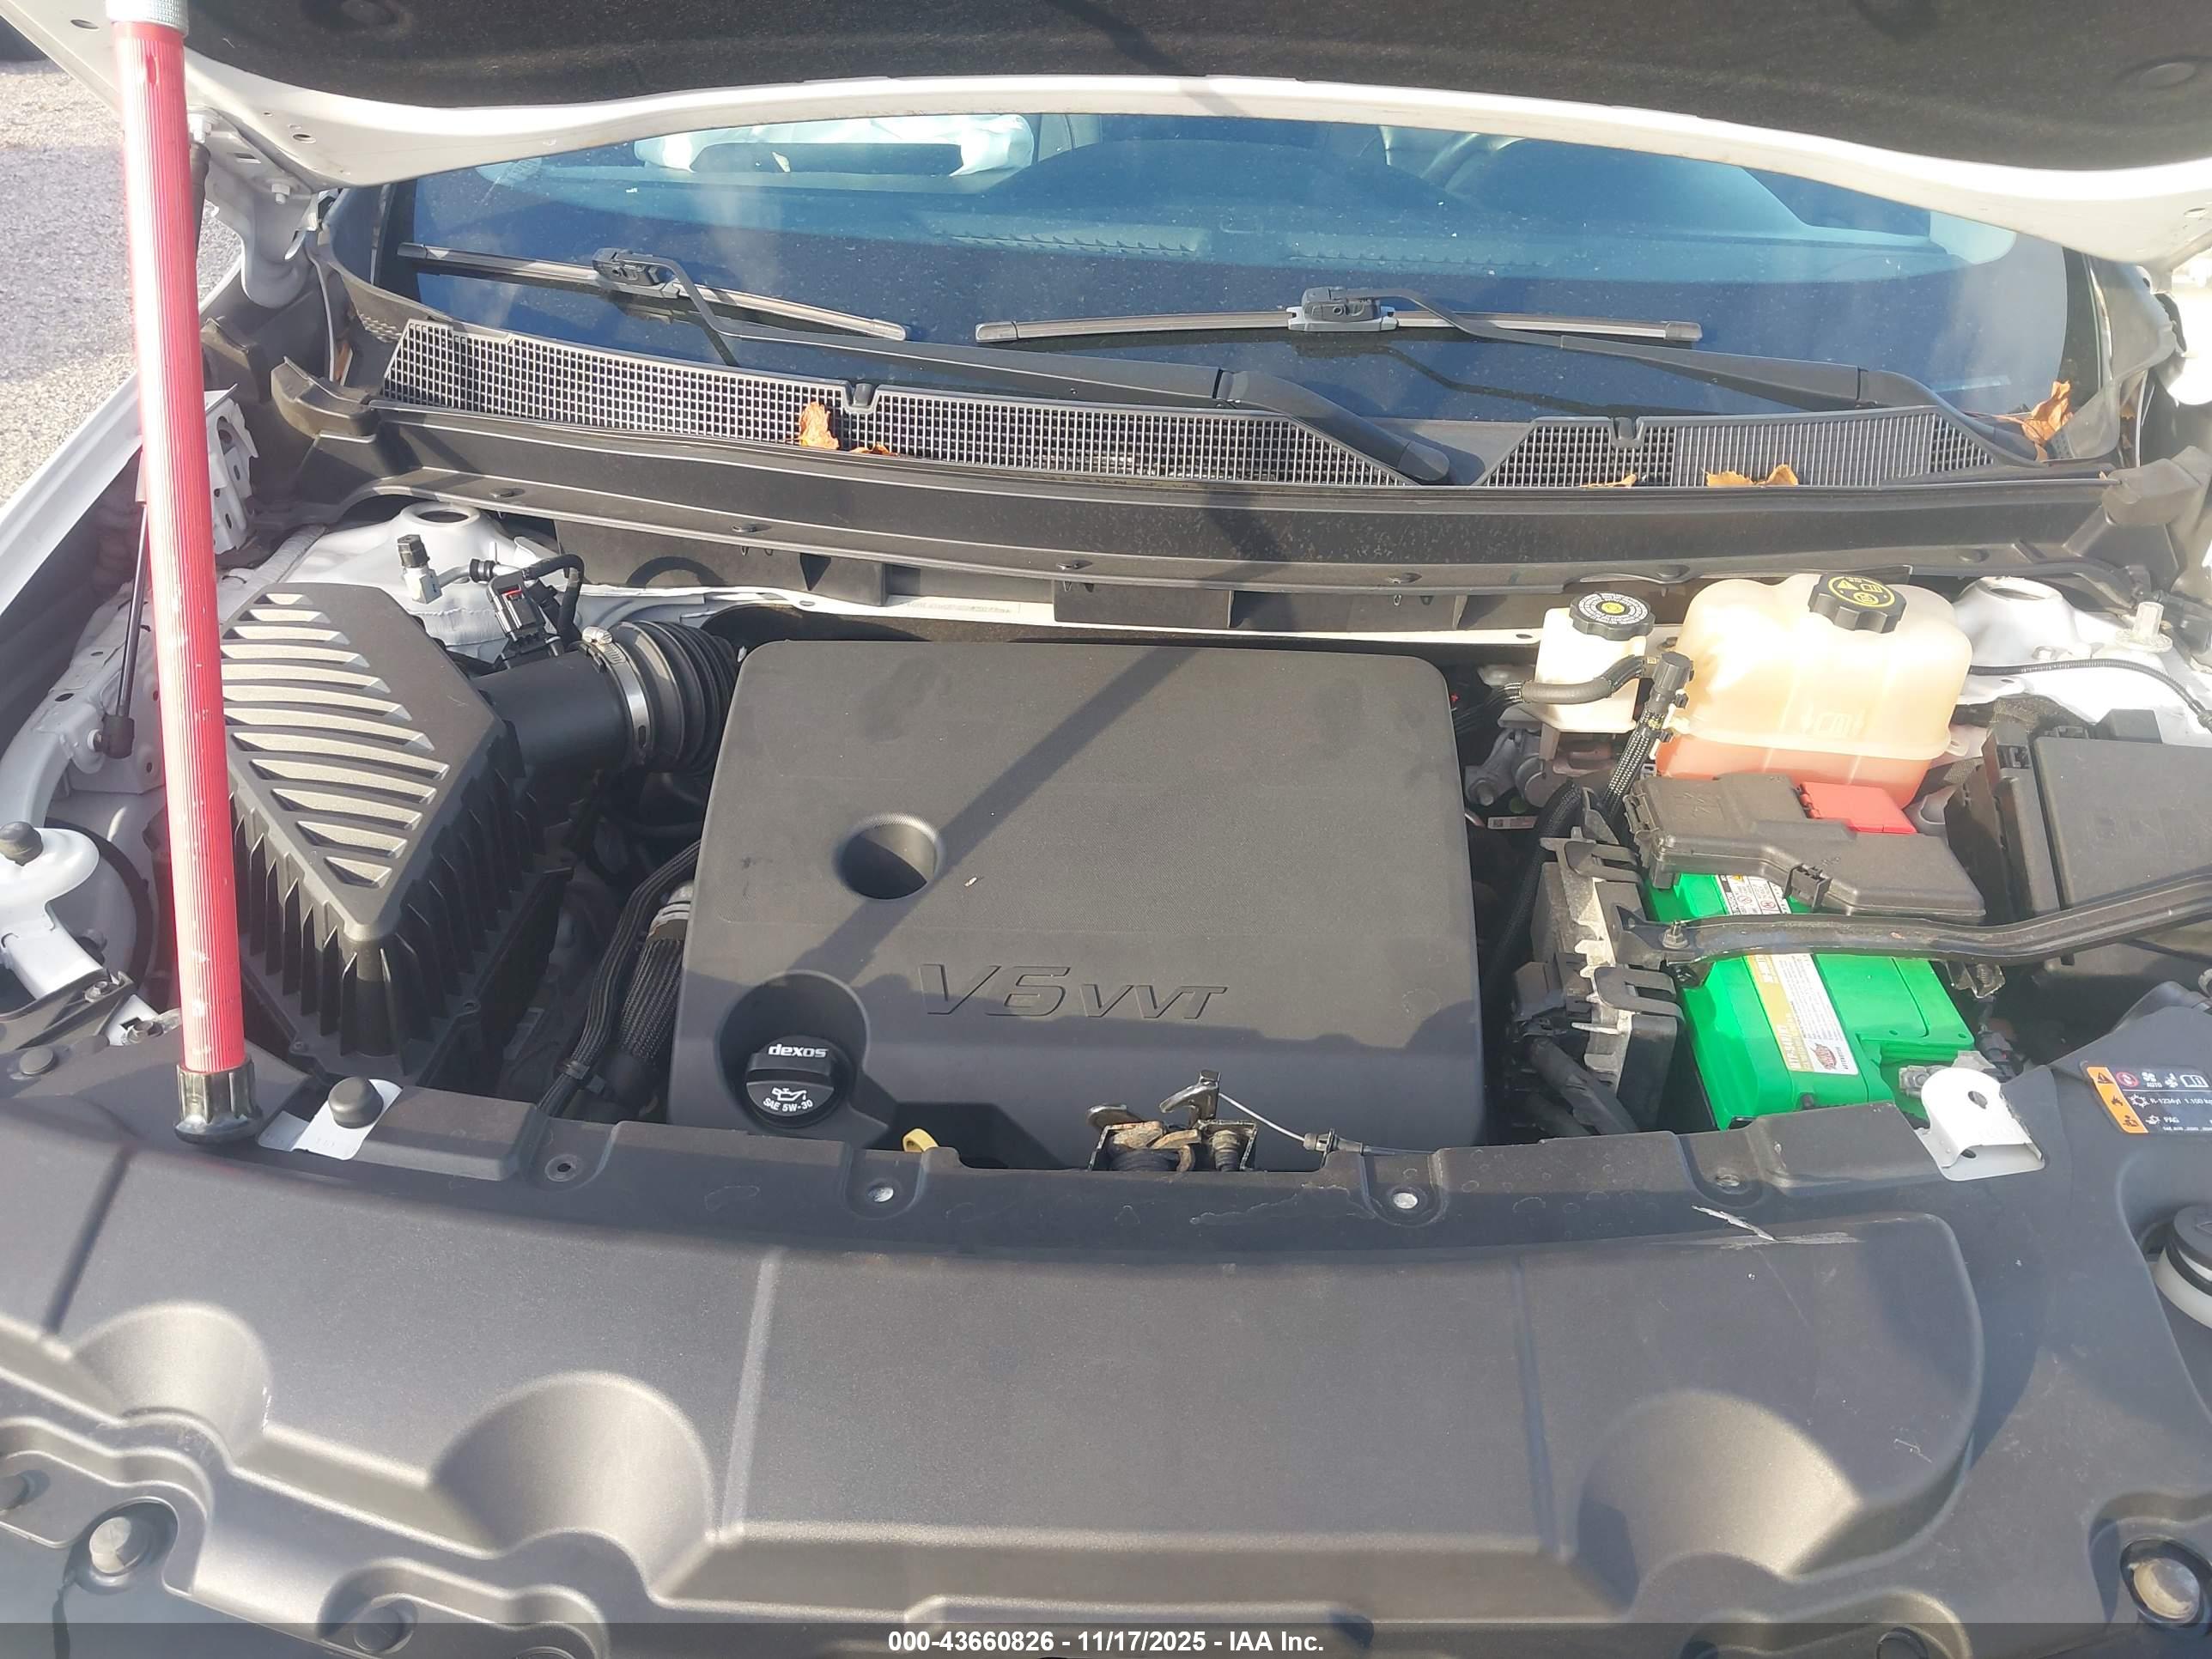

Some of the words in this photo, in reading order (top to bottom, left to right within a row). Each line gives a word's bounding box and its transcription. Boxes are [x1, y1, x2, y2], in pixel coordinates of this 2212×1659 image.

[918, 963, 1071, 1017] V6
[1079, 983, 1229, 1019] VVT
[768, 1043, 830, 1058] dexos
[763, 1097, 781, 1111] SAE
[781, 1099, 814, 1112] 5W-30
